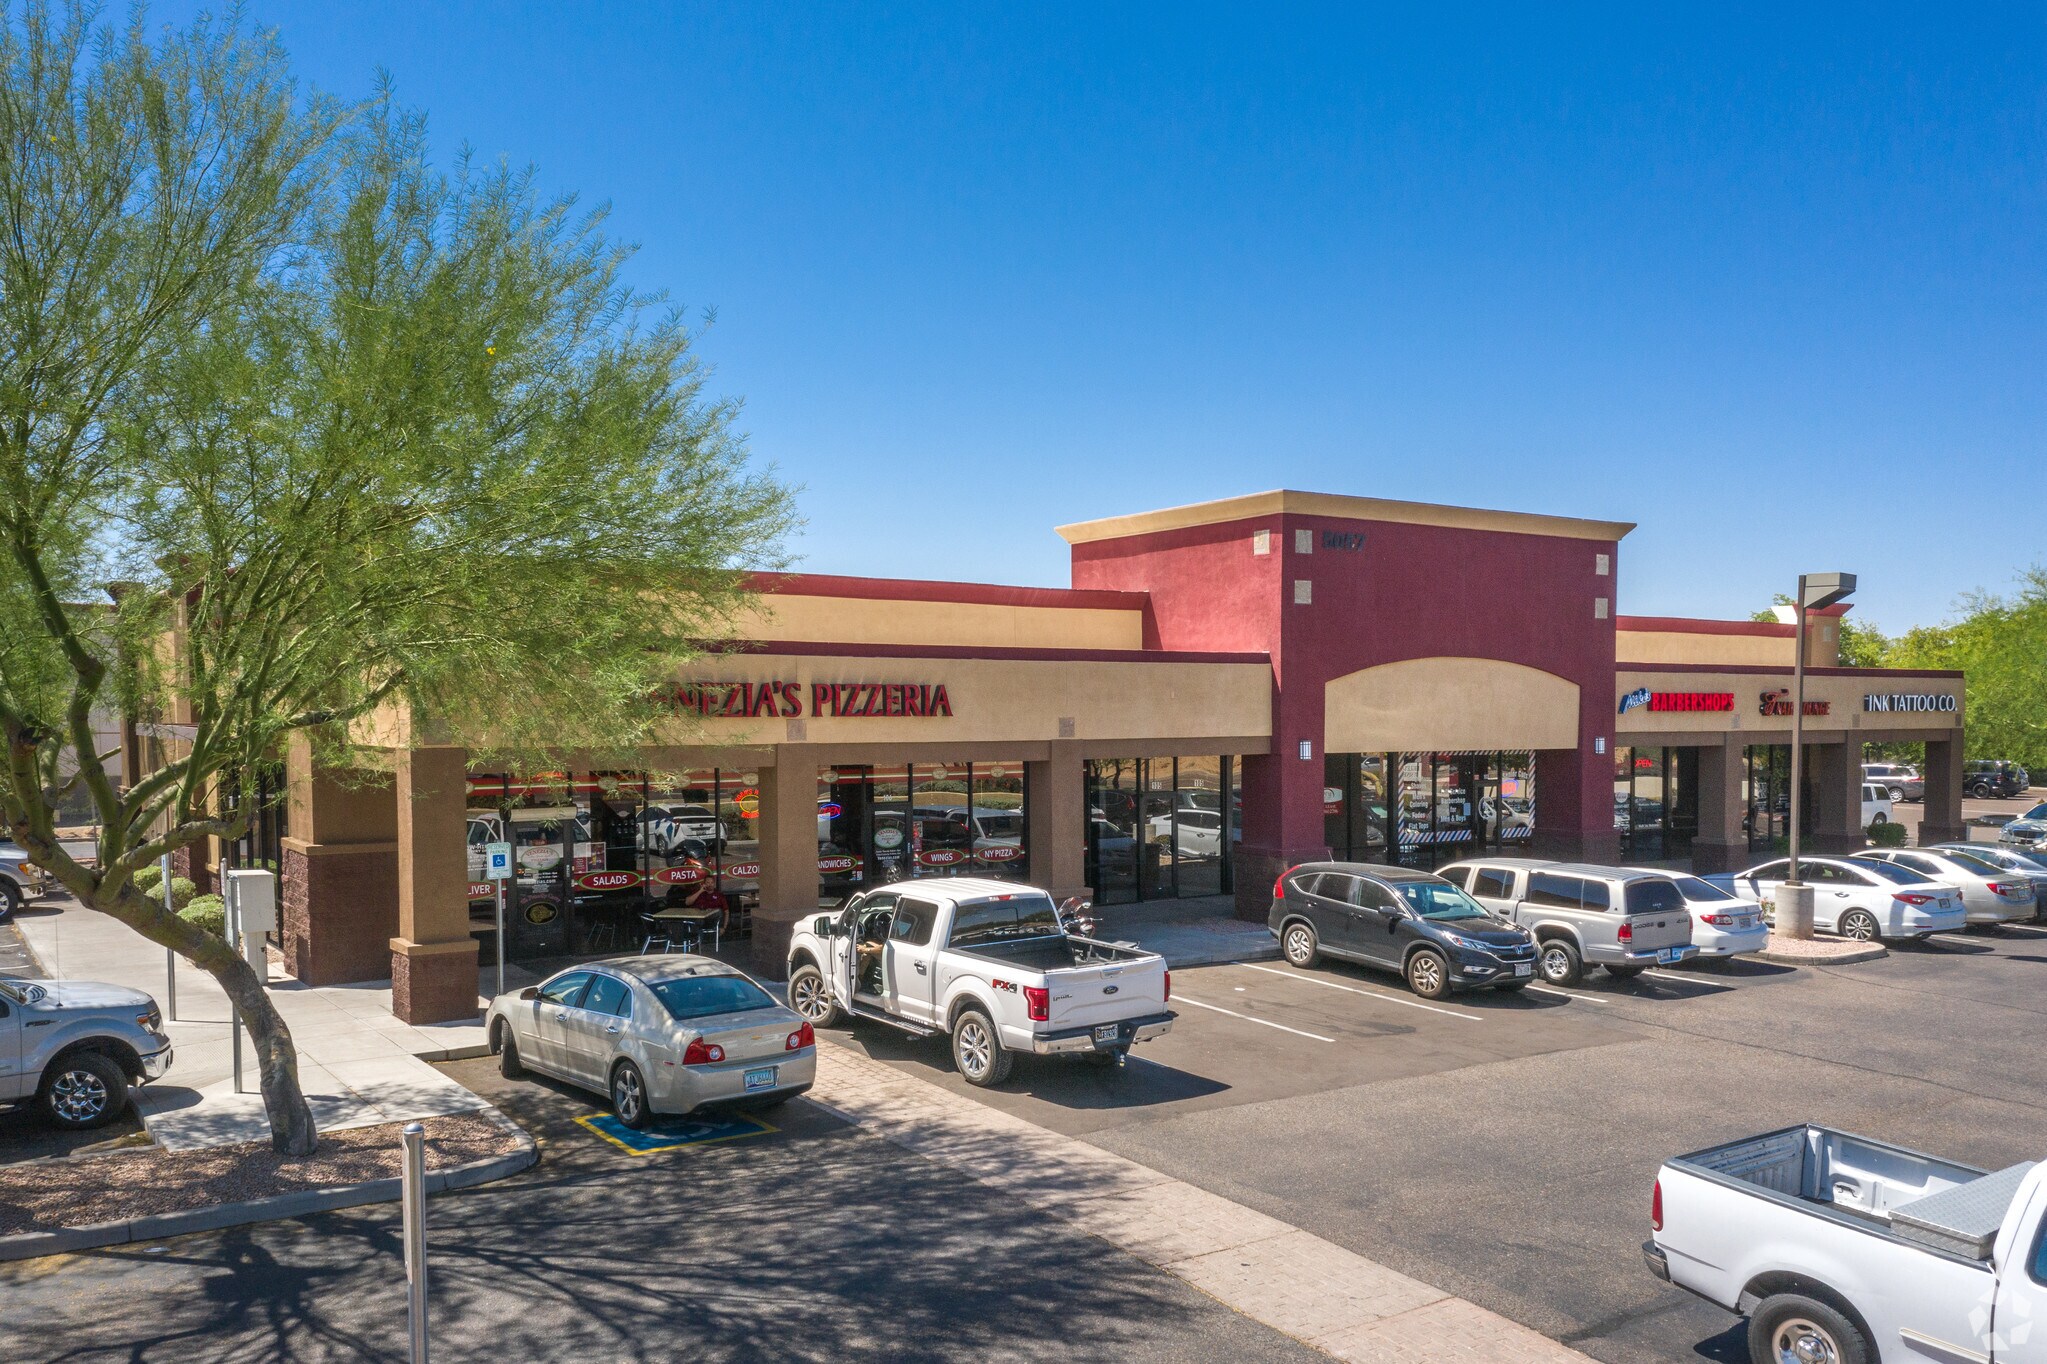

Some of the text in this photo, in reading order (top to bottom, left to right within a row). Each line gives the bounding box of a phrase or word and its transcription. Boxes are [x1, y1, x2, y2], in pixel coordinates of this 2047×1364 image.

[652, 680, 953, 718] NEZIA'S PIZZERIA
[1650, 692, 1734, 711] BARBERSHOPS
[1868, 694, 1958, 711] INK TATTOO CO.
[1801, 701, 1831, 715] OUNGE
[930, 852, 953, 862] WINGS
[984, 848, 1013, 858] NY PIZZA
[817, 858, 852, 868] ANDWICHES
[593, 874, 628, 886] SALADS
[670, 870, 697, 880] PASTA
[467, 884, 491, 895] IVER
[992, 978, 1018, 993] FX4
